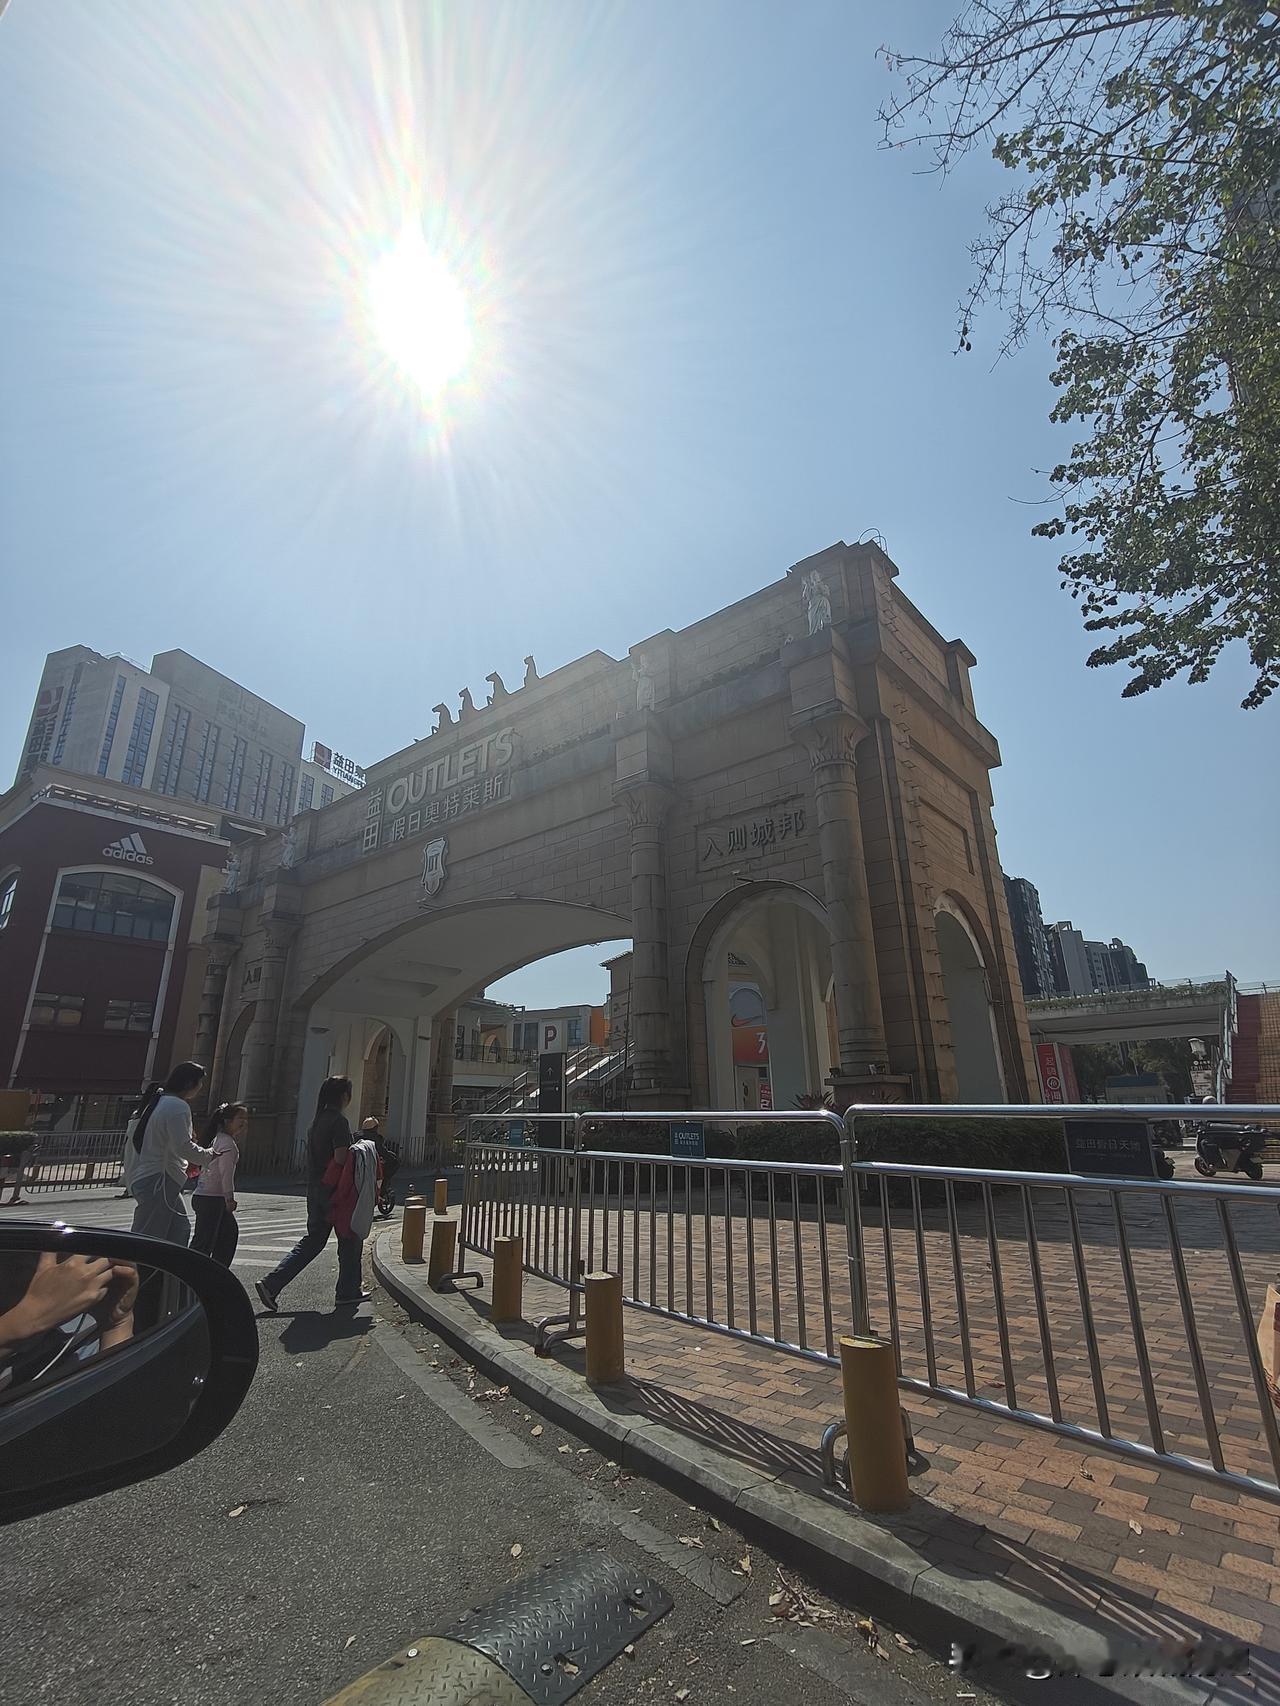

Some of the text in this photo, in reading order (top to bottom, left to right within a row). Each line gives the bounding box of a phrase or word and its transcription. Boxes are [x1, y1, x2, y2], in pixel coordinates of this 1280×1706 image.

[386, 726, 514, 814] OUTLETS
[363, 787, 383, 852] 益田
[391, 773, 503, 841] 假日奥特莱斯
[703, 808, 806, 861] 入则城邦
[102, 847, 154, 865] adidas
[544, 1025, 557, 1050] P
